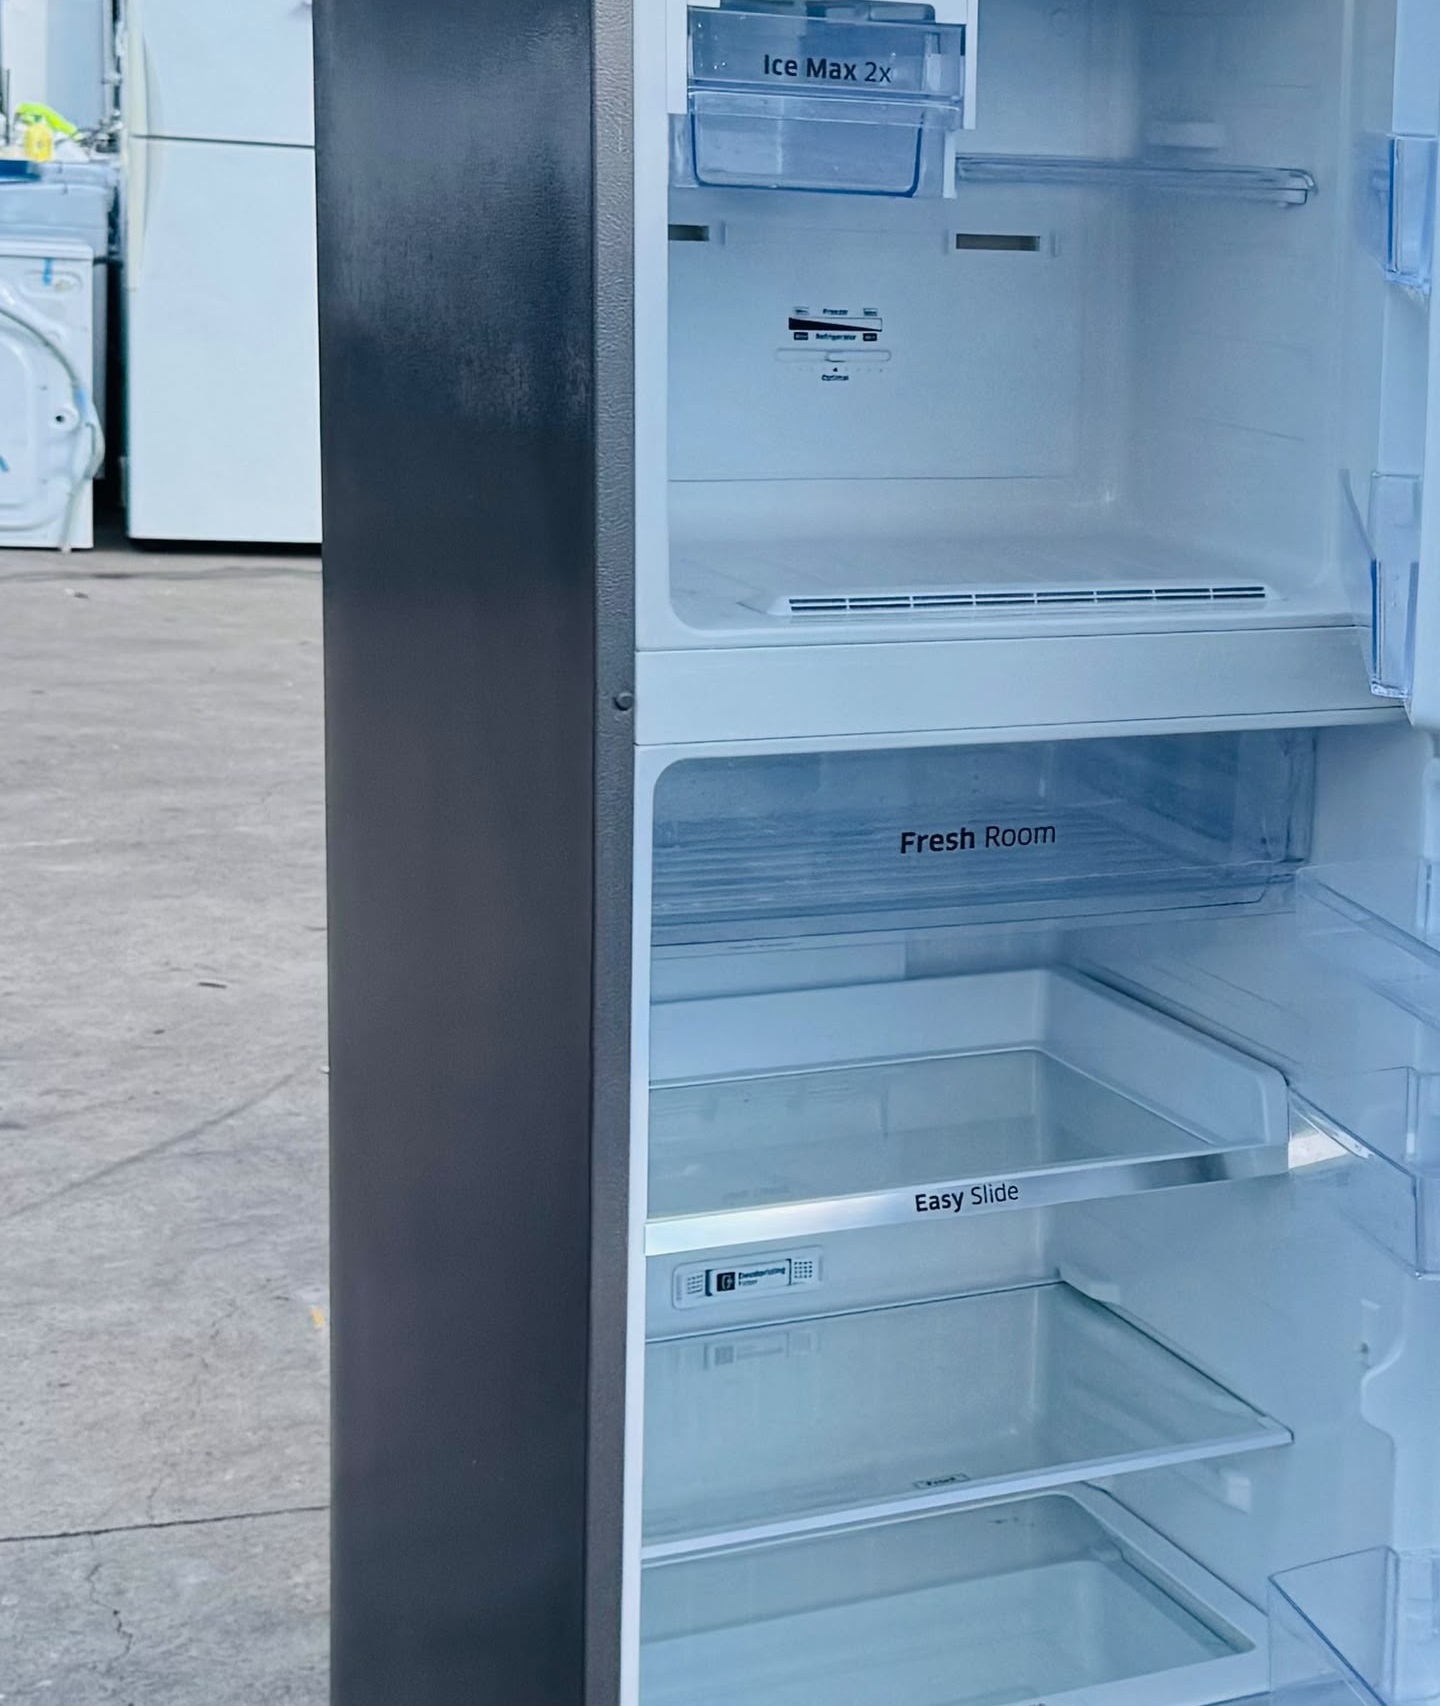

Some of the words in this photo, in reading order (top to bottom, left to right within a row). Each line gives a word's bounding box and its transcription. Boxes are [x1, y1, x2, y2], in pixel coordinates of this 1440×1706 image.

[764, 54, 798, 77] Ice
[806, 57, 857, 81] Max
[864, 61, 891, 83] 2x
[900, 827, 976, 854] Fresh
[985, 825, 1056, 848] Room
[915, 1191, 964, 1213] Easy
[970, 1183, 1019, 1205] Slide
